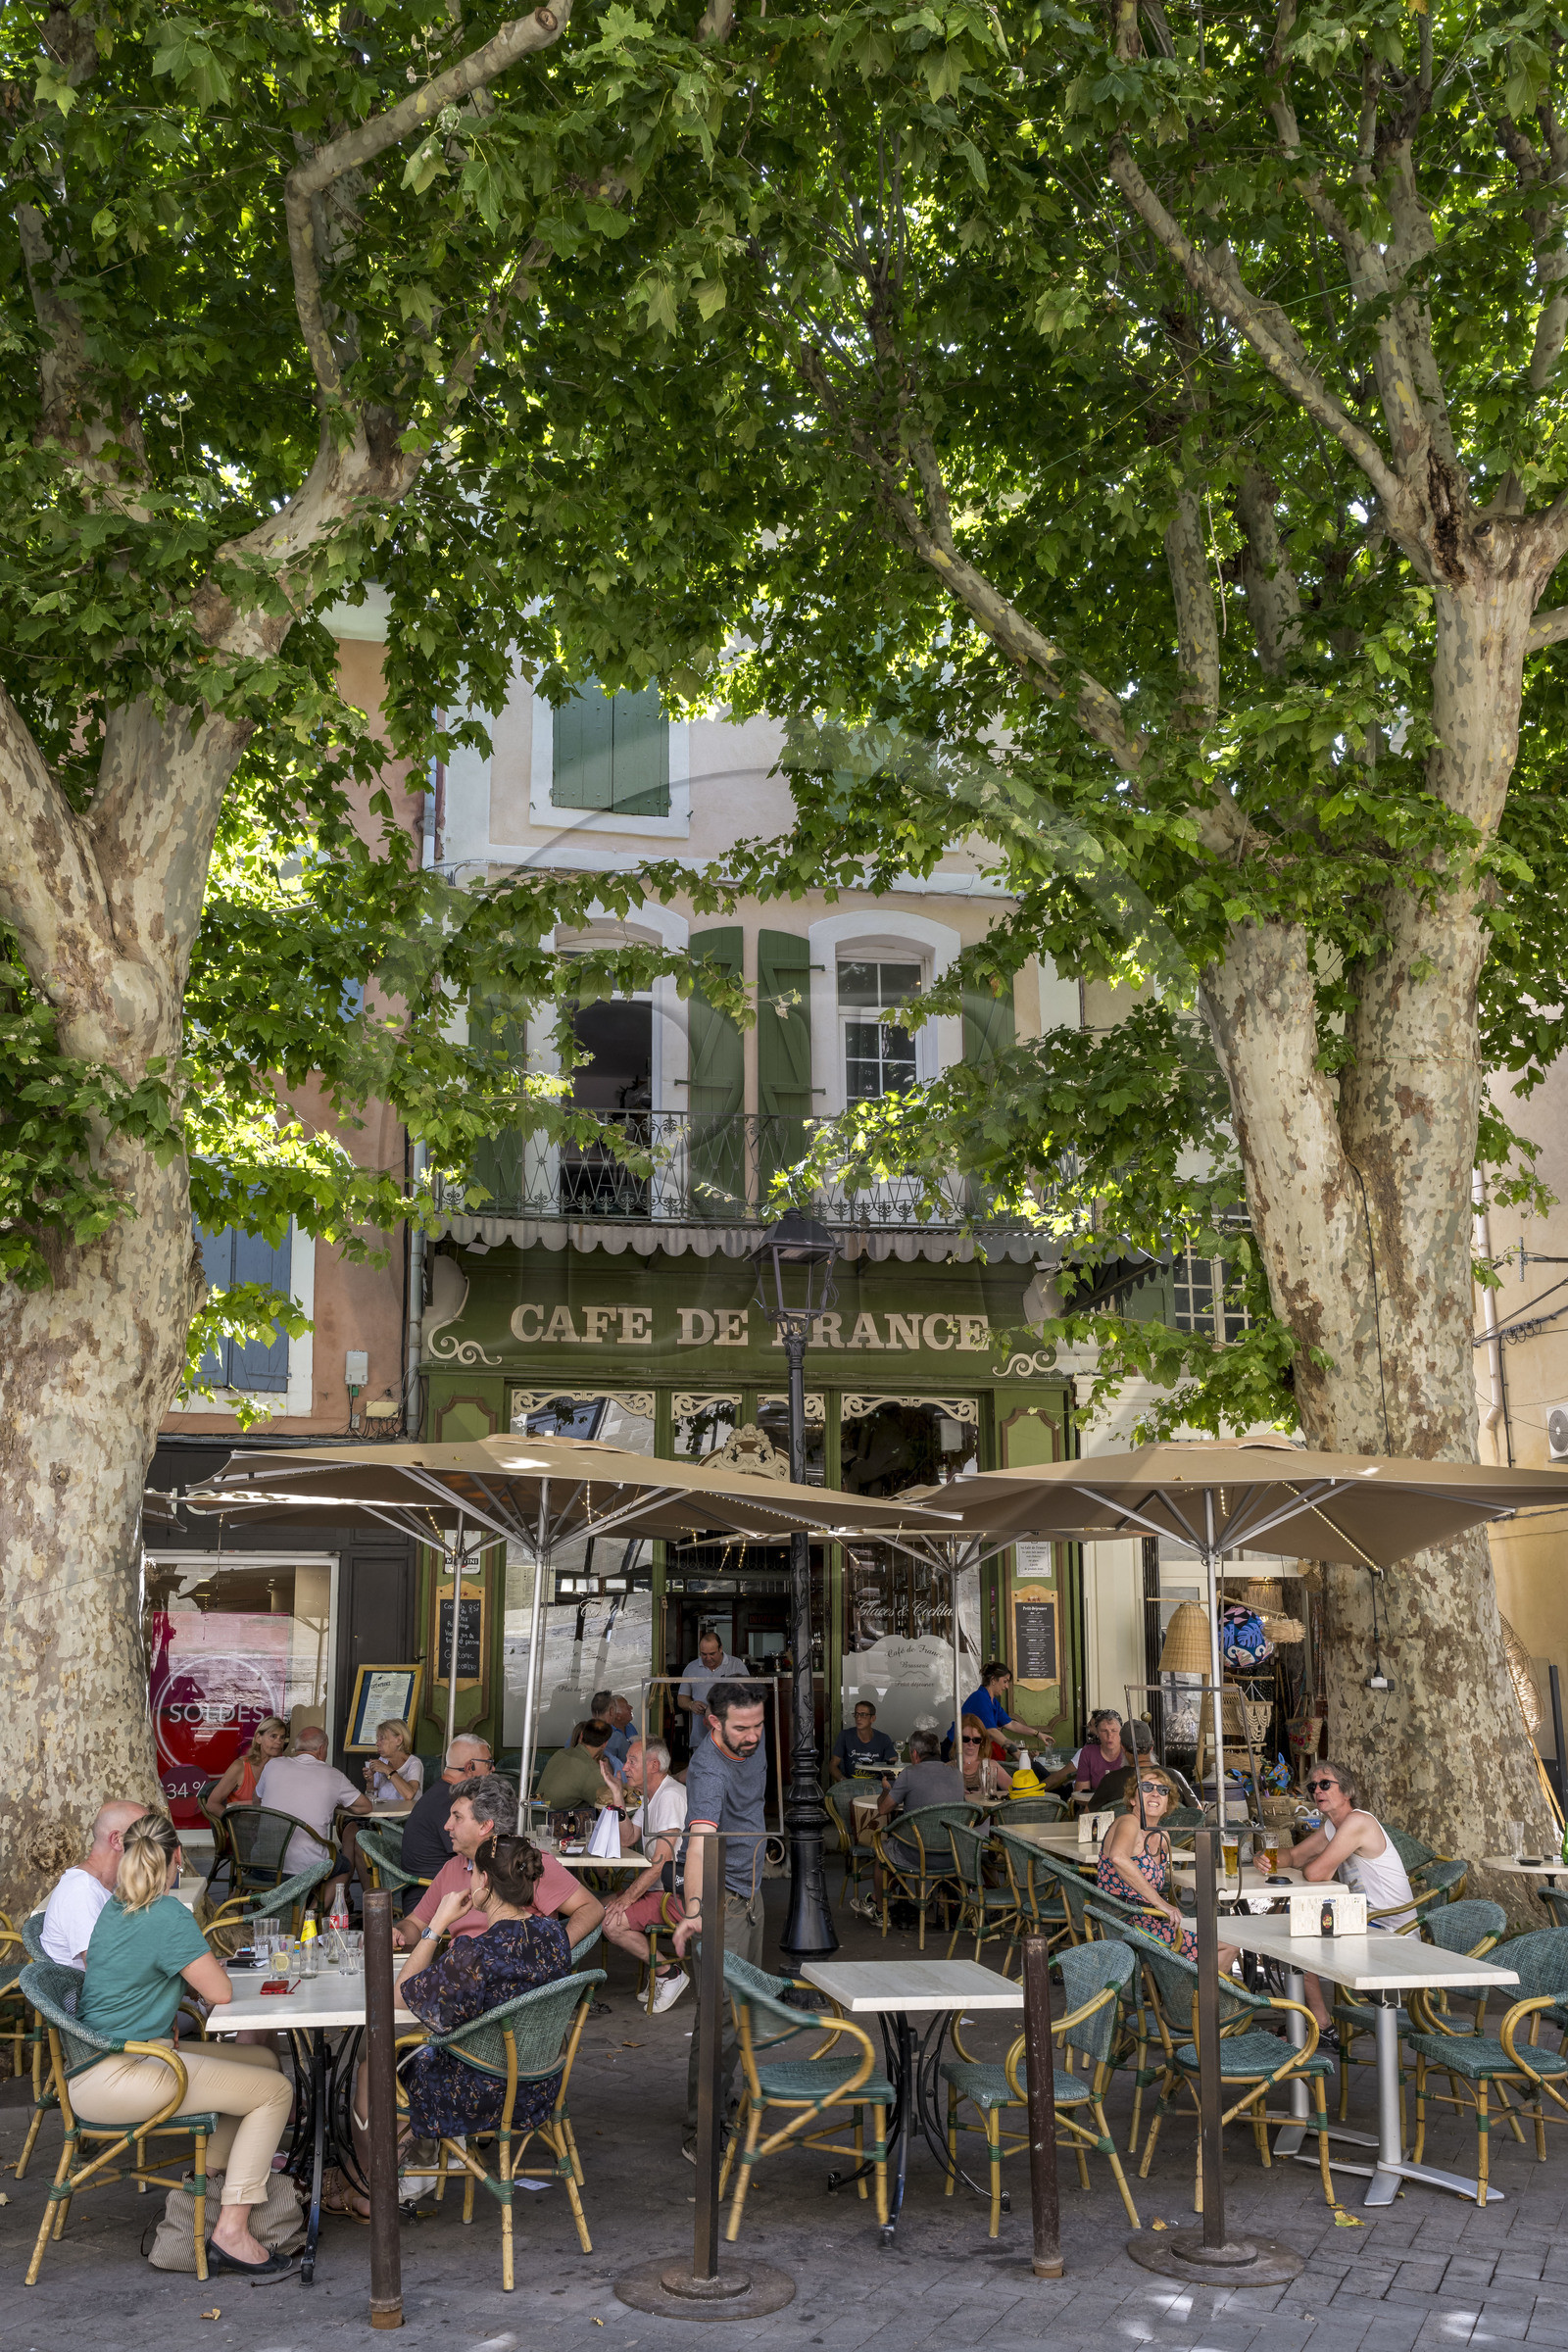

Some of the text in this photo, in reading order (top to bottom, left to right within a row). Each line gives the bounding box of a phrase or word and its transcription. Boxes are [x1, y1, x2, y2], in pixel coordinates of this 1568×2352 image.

[510, 1303, 653, 1345] CAFE
[676, 1308, 750, 1347] DE
[857, 1599, 954, 1617] Glaces & Cockta
[885, 1646, 906, 1658] Café
[918, 1644, 944, 1658] France
[169, 1702, 265, 1724] SOLDES
